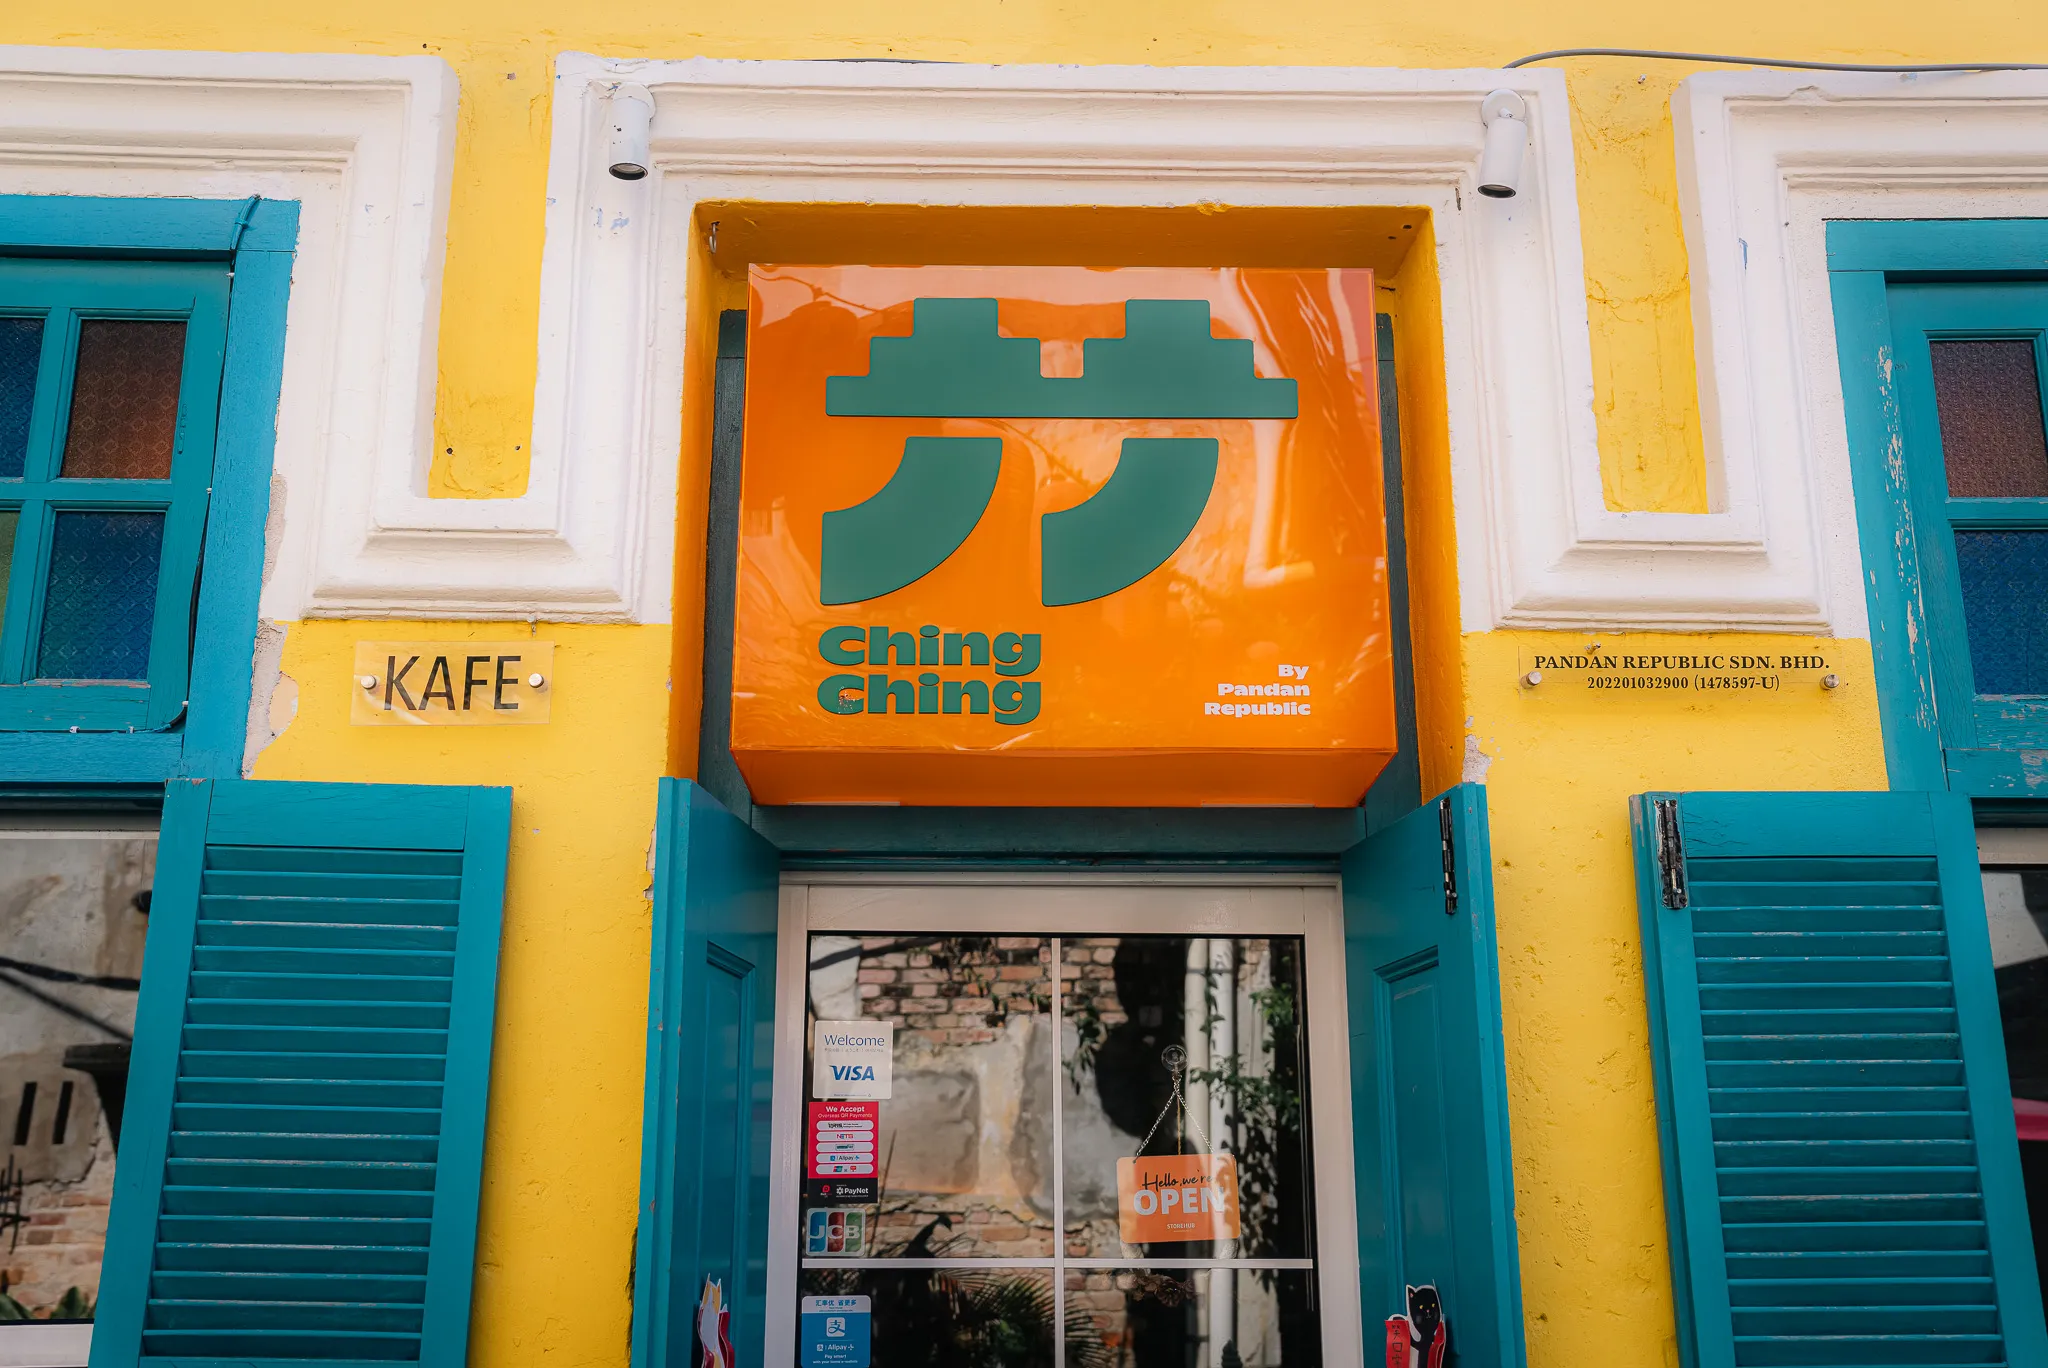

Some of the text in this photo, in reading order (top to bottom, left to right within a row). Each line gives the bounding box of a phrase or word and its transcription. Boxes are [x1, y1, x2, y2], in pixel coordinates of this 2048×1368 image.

[818, 624, 1042, 677] Ching
[1534, 655, 1830, 669] PANDAN REPUBLIC SDN. BHD.
[1278, 664, 1309, 680] By
[384, 655, 522, 711] KAFE
[1217, 683, 1310, 697] Pandan
[1587, 675, 1780, 691] 202201032900 (1478597-U)
[817, 672, 1042, 726] Ching
[1204, 702, 1311, 718] Republic
[824, 1034, 885, 1047] Welcome
[829, 1065, 875, 1081] VISA
[1133, 1186, 1225, 1216] OPEN
[808, 1224, 860, 1240] JCB
[1166, 1222, 1196, 1230] STOREHUB
